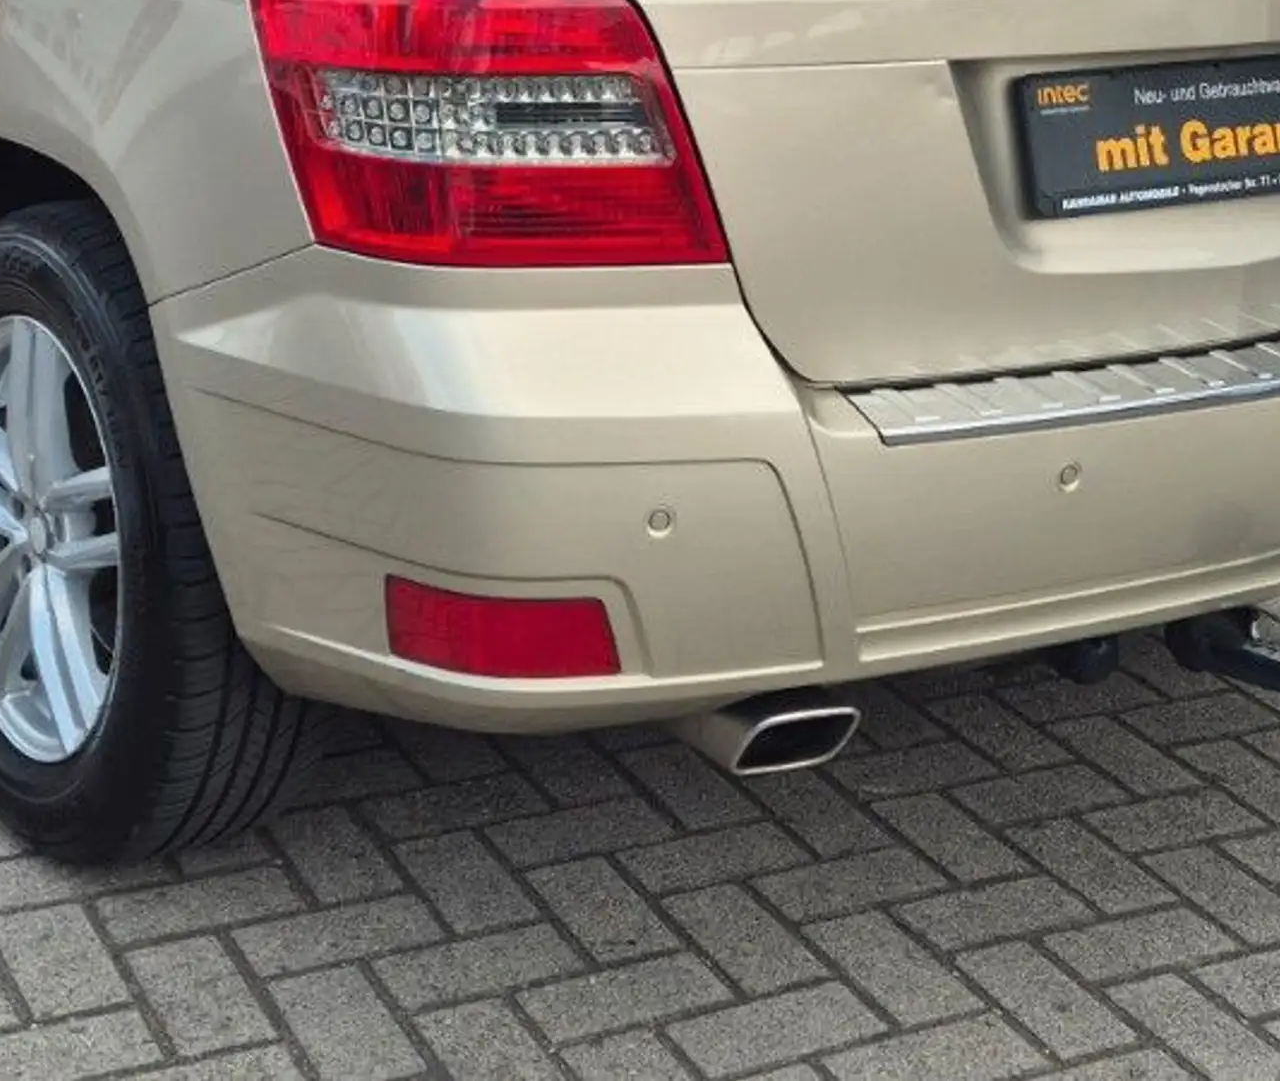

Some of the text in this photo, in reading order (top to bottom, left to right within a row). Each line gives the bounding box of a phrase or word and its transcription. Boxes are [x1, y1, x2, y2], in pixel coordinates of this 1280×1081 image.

[1037, 83, 1090, 106] intec
[1133, 87, 1167, 105] Neu-
[1170, 83, 1197, 102] und
[1094, 123, 1169, 173] mit
